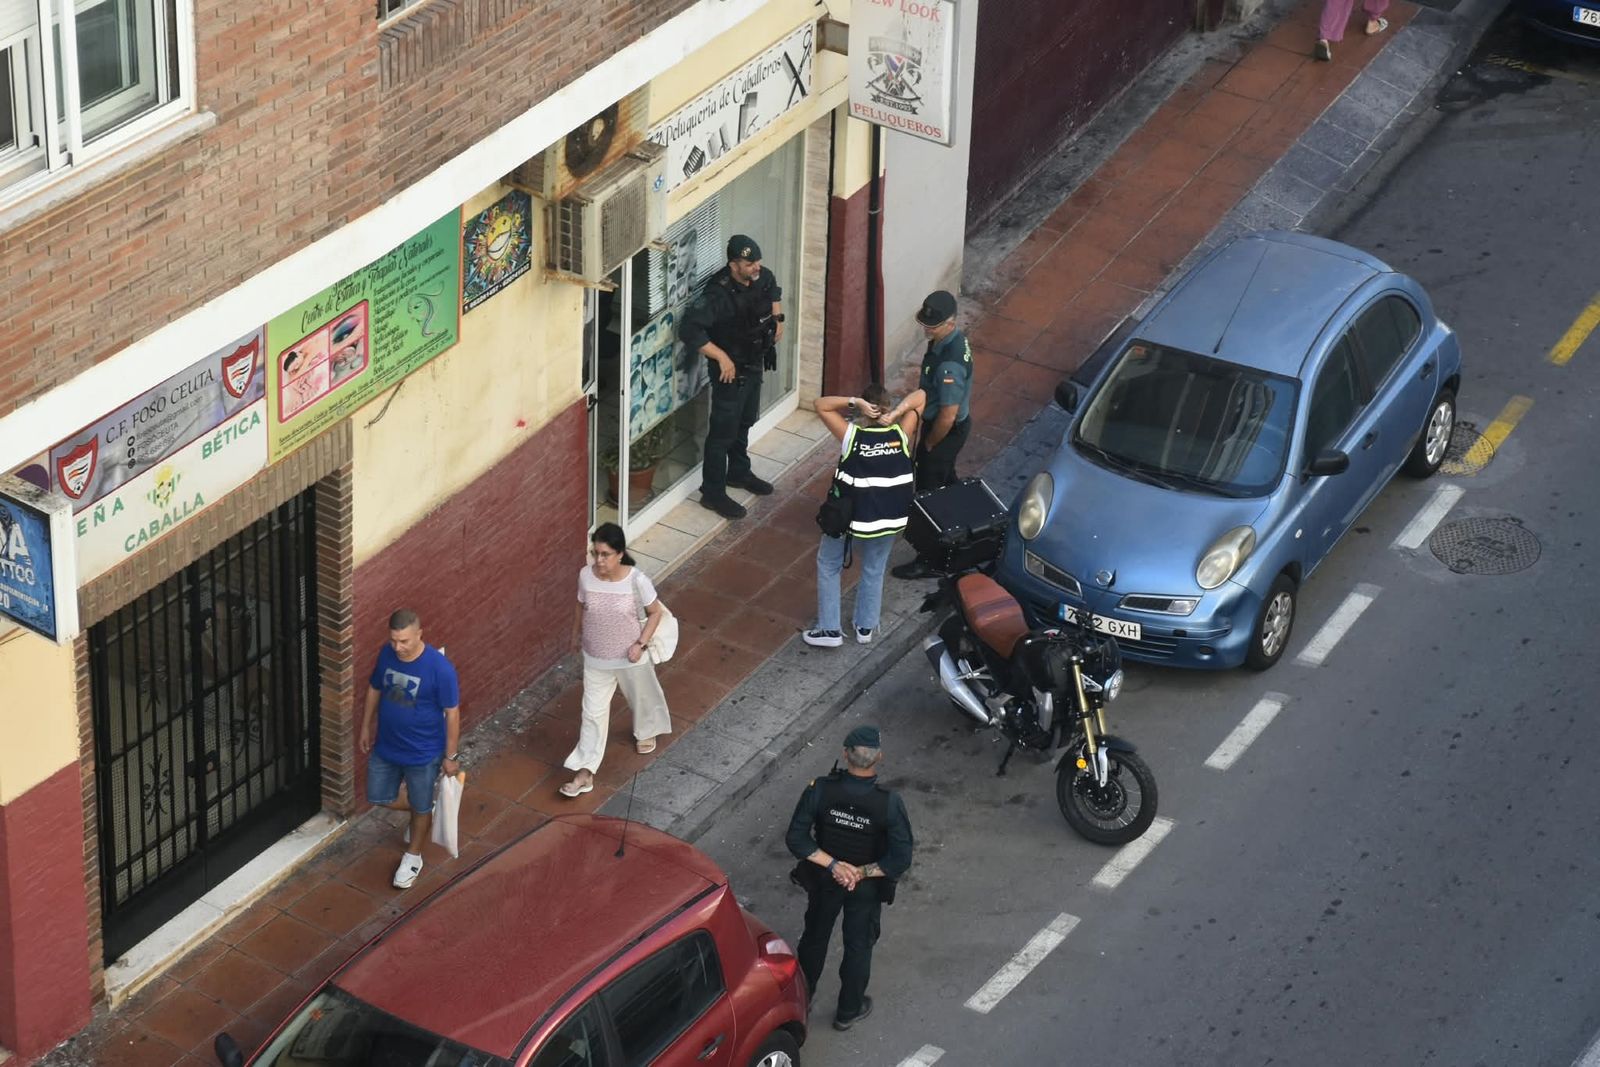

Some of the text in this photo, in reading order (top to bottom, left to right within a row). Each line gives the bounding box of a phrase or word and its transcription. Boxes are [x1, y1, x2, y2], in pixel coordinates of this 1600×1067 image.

[900, 0, 940, 22] LOOK
[1583, 10, 1600, 24] 76
[719, 88, 730, 110] de
[733, 57, 782, 104] Caballeros
[853, 103, 942, 138] PELUQUEROS
[105, 368, 215, 444] C.F. FOSO CEUTA
[854, 447, 902, 457] ACIONAL
[76, 497, 124, 537] EÑA
[202, 411, 261, 459] BÉTICA
[124, 493, 205, 552] CABALLA
[0, 558, 36, 586] TTOO
[1067, 608, 1137, 637] 72 GXH
